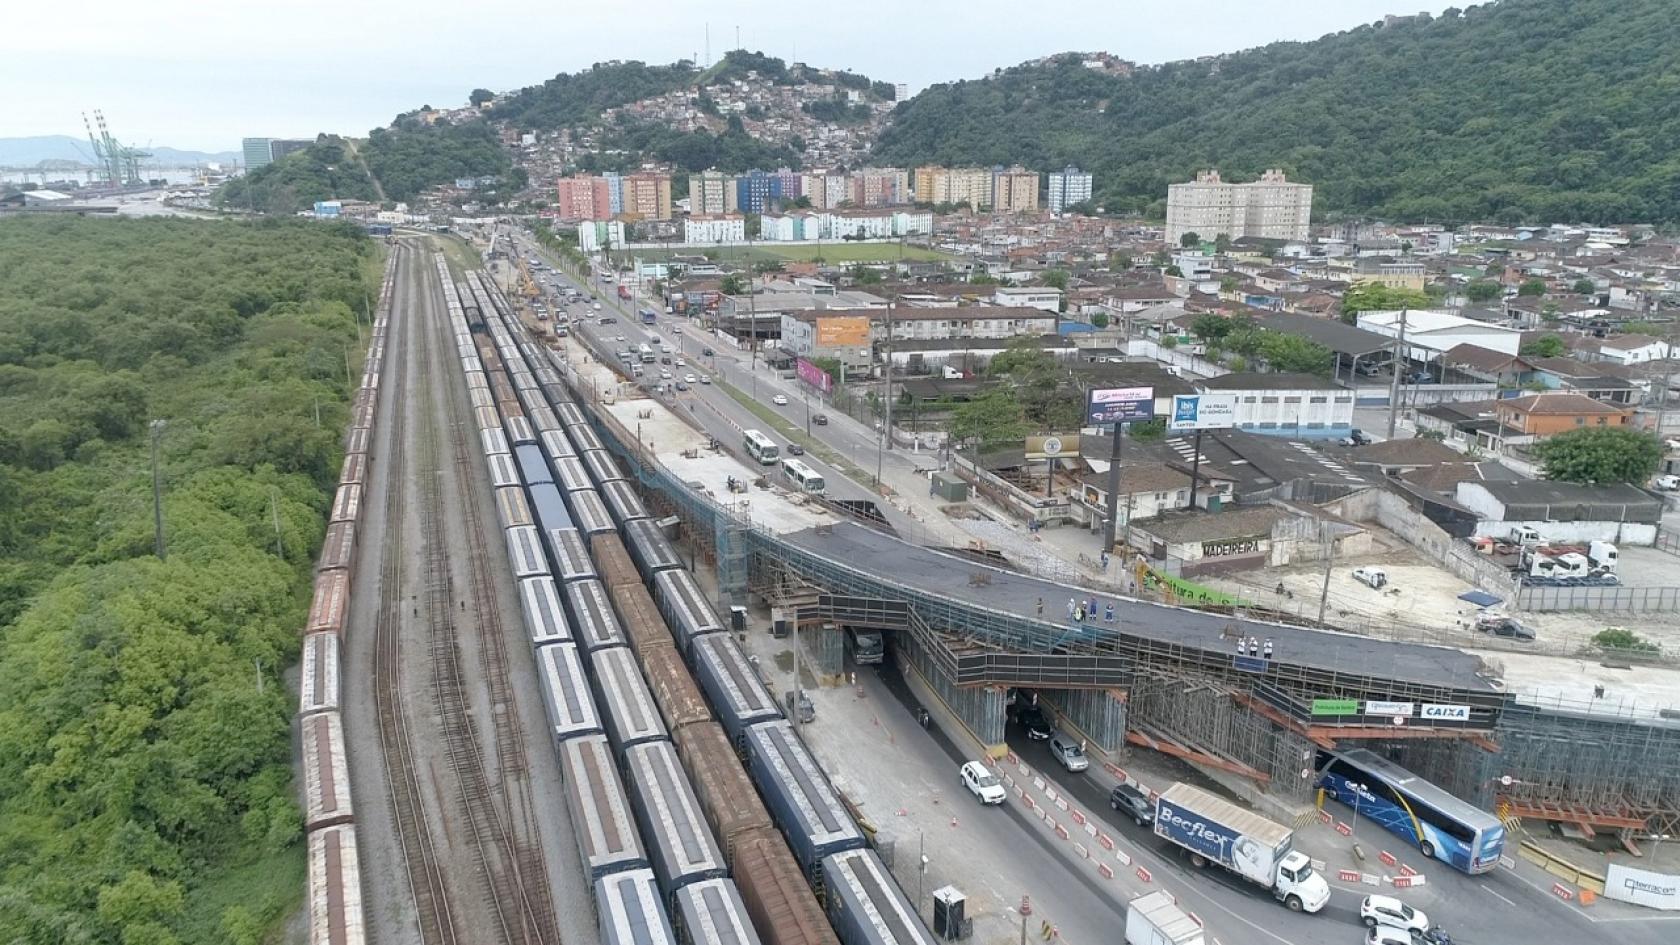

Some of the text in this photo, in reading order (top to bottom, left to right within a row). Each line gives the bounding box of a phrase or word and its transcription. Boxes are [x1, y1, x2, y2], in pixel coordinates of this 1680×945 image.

[1203, 540, 1259, 557] MADEIREIRA
[1426, 706, 1464, 717] CAIXA
[1159, 806, 1229, 844] Becflex
[1635, 880, 1676, 894] terracom
